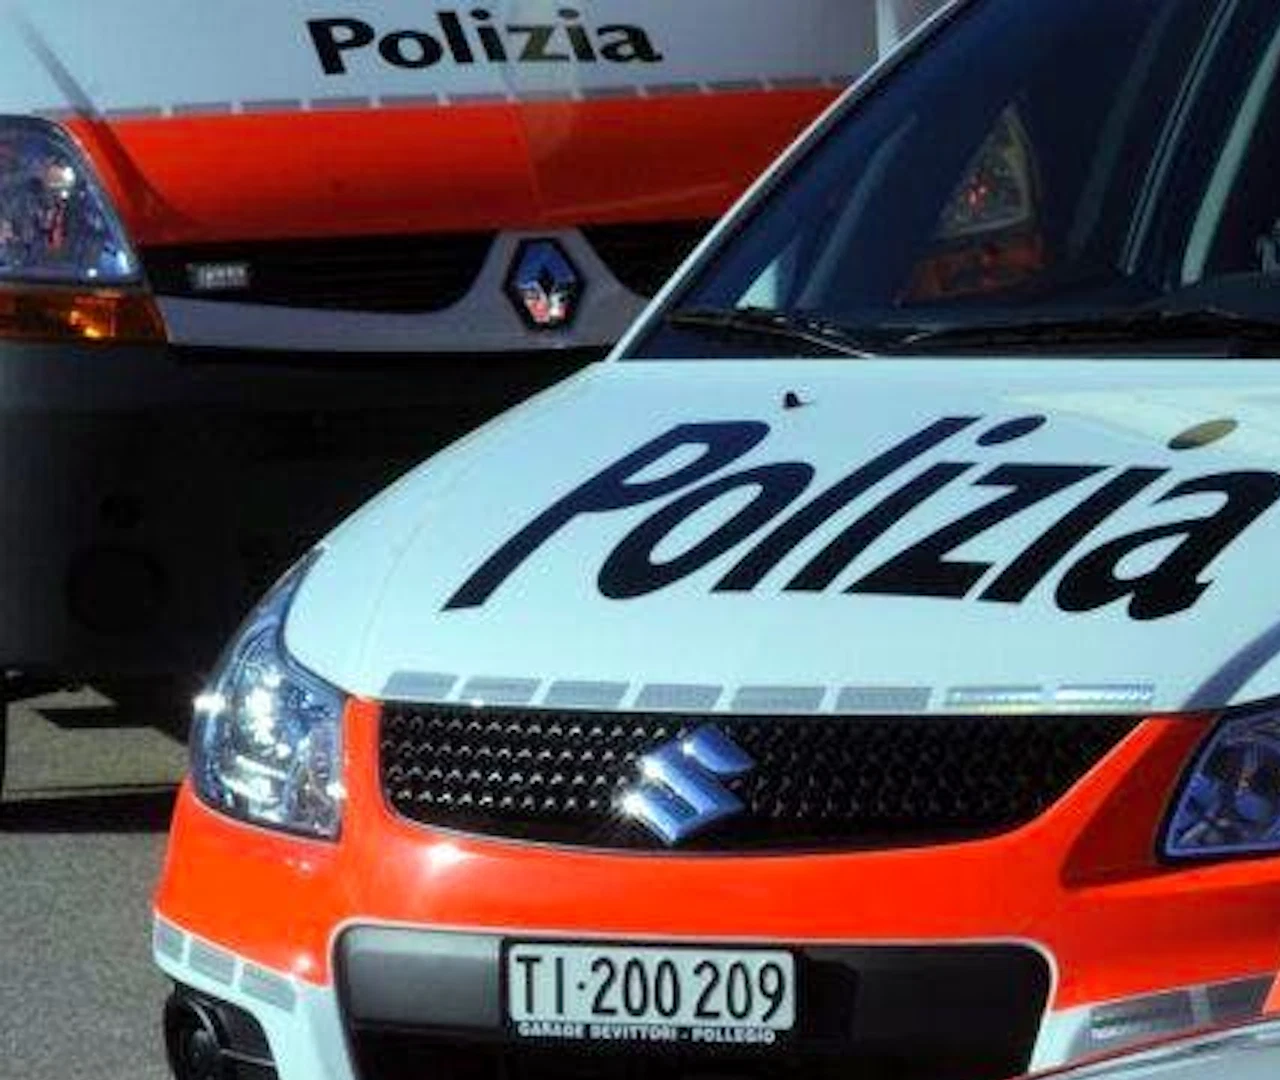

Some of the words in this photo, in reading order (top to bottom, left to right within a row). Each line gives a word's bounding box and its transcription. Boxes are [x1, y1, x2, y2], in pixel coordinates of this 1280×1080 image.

[306, 8, 663, 76] Polizia
[517, 1021, 585, 1039] GARAGE
[590, 1023, 678, 1041] DEVITTORI
[692, 1026, 776, 1044] POLLEGIO
